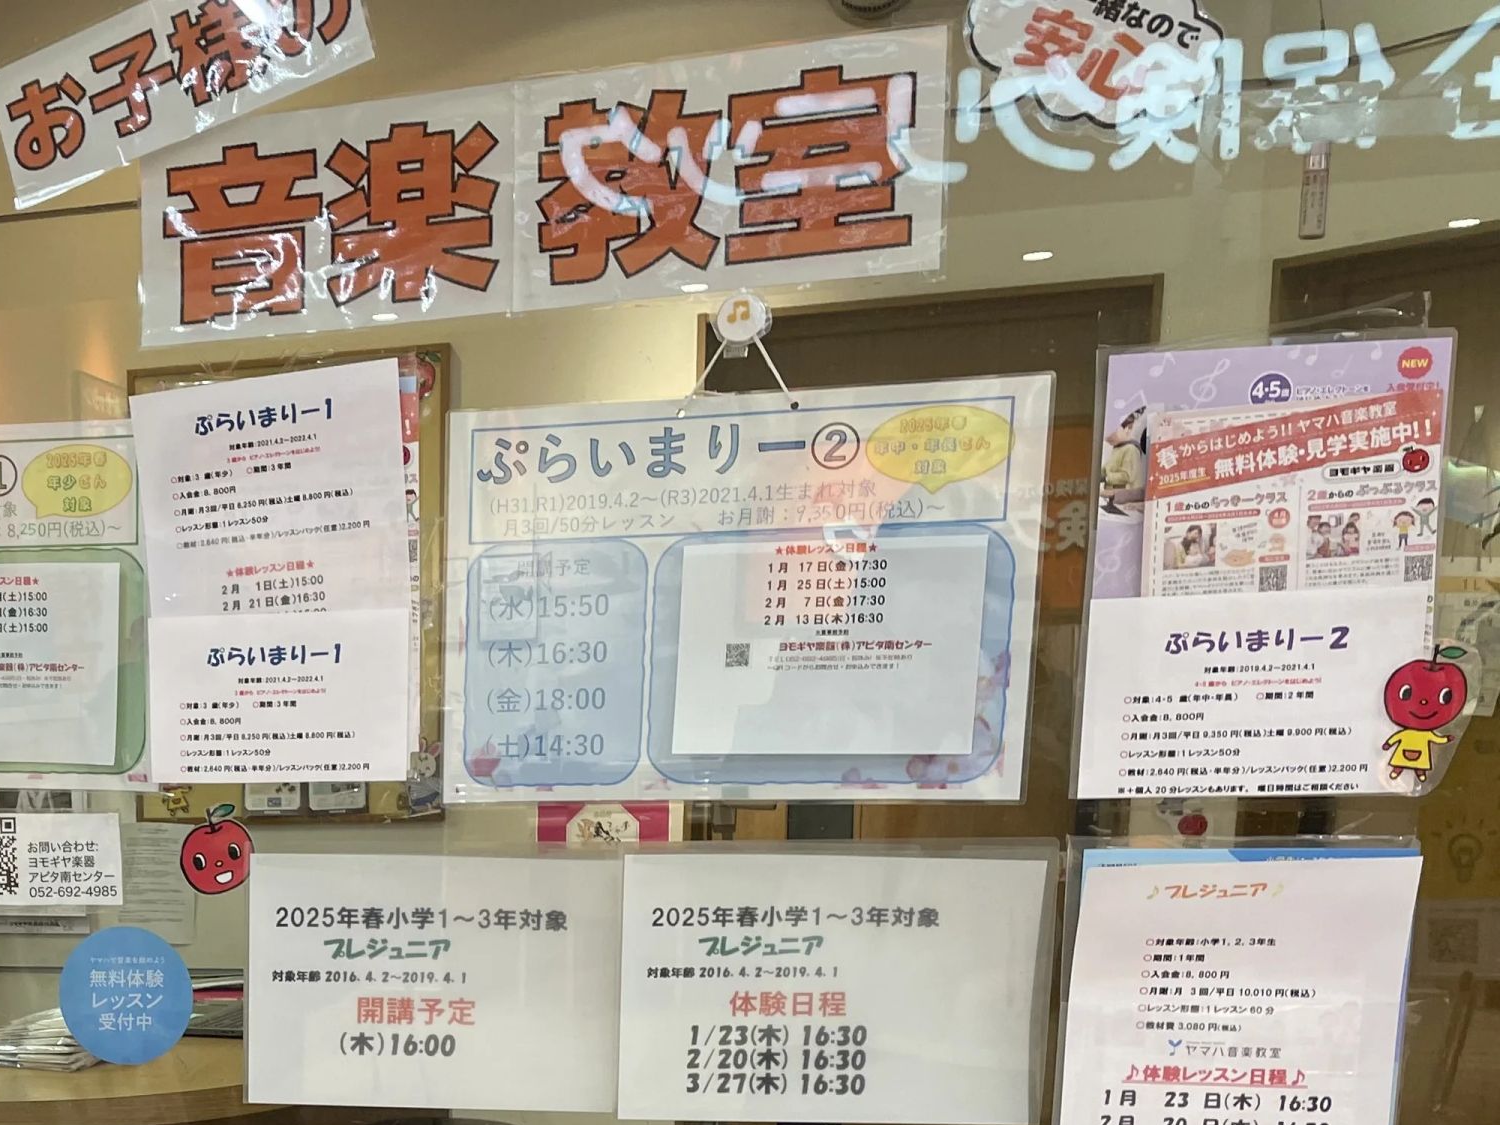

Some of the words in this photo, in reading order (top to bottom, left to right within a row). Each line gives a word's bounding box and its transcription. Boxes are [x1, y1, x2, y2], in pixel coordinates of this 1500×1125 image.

[1087, 0, 1200, 48] 緒なので
[163, 64, 918, 325] 音楽教室
[1402, 359, 1428, 370] NEW
[1298, 402, 1397, 434] ヤマハ音楽教室
[63, 497, 92, 512] 対象
[488, 641, 608, 666] (木)16:30
[486, 688, 605, 713] (金)18:00
[28, 856, 95, 869] ヨモギヤ楽器
[28, 870, 115, 883] アピタ南センター
[29, 885, 117, 898] 052-692-4985
[1165, 882, 1268, 899] プレジュニア
[324, 938, 451, 959] プレジュニア
[698, 936, 824, 956] プレジュニア
[89, 969, 164, 988] 無料体験
[91, 991, 163, 1009] レッスン
[356, 996, 476, 1025] 開講予定
[730, 990, 847, 1017] 体験日程
[98, 1013, 152, 1032] 受付中
[339, 1032, 456, 1057] (木)16:00
[690, 1024, 789, 1047] 1/23(木)
[802, 1025, 867, 1047] 16:30
[686, 1049, 788, 1070] 2/20(木)
[801, 1049, 866, 1070] 16:30
[1186, 1044, 1282, 1059] ヤマハ音楽教室
[686, 1073, 787, 1095] 3/27(木)
[800, 1073, 866, 1095] 16:30
[1143, 1065, 1288, 1086] 体験レッスン日程
[1103, 1089, 1137, 1107] 1月
[1164, 1092, 1189, 1108] 23
[1278, 1094, 1332, 1112] 16:30
